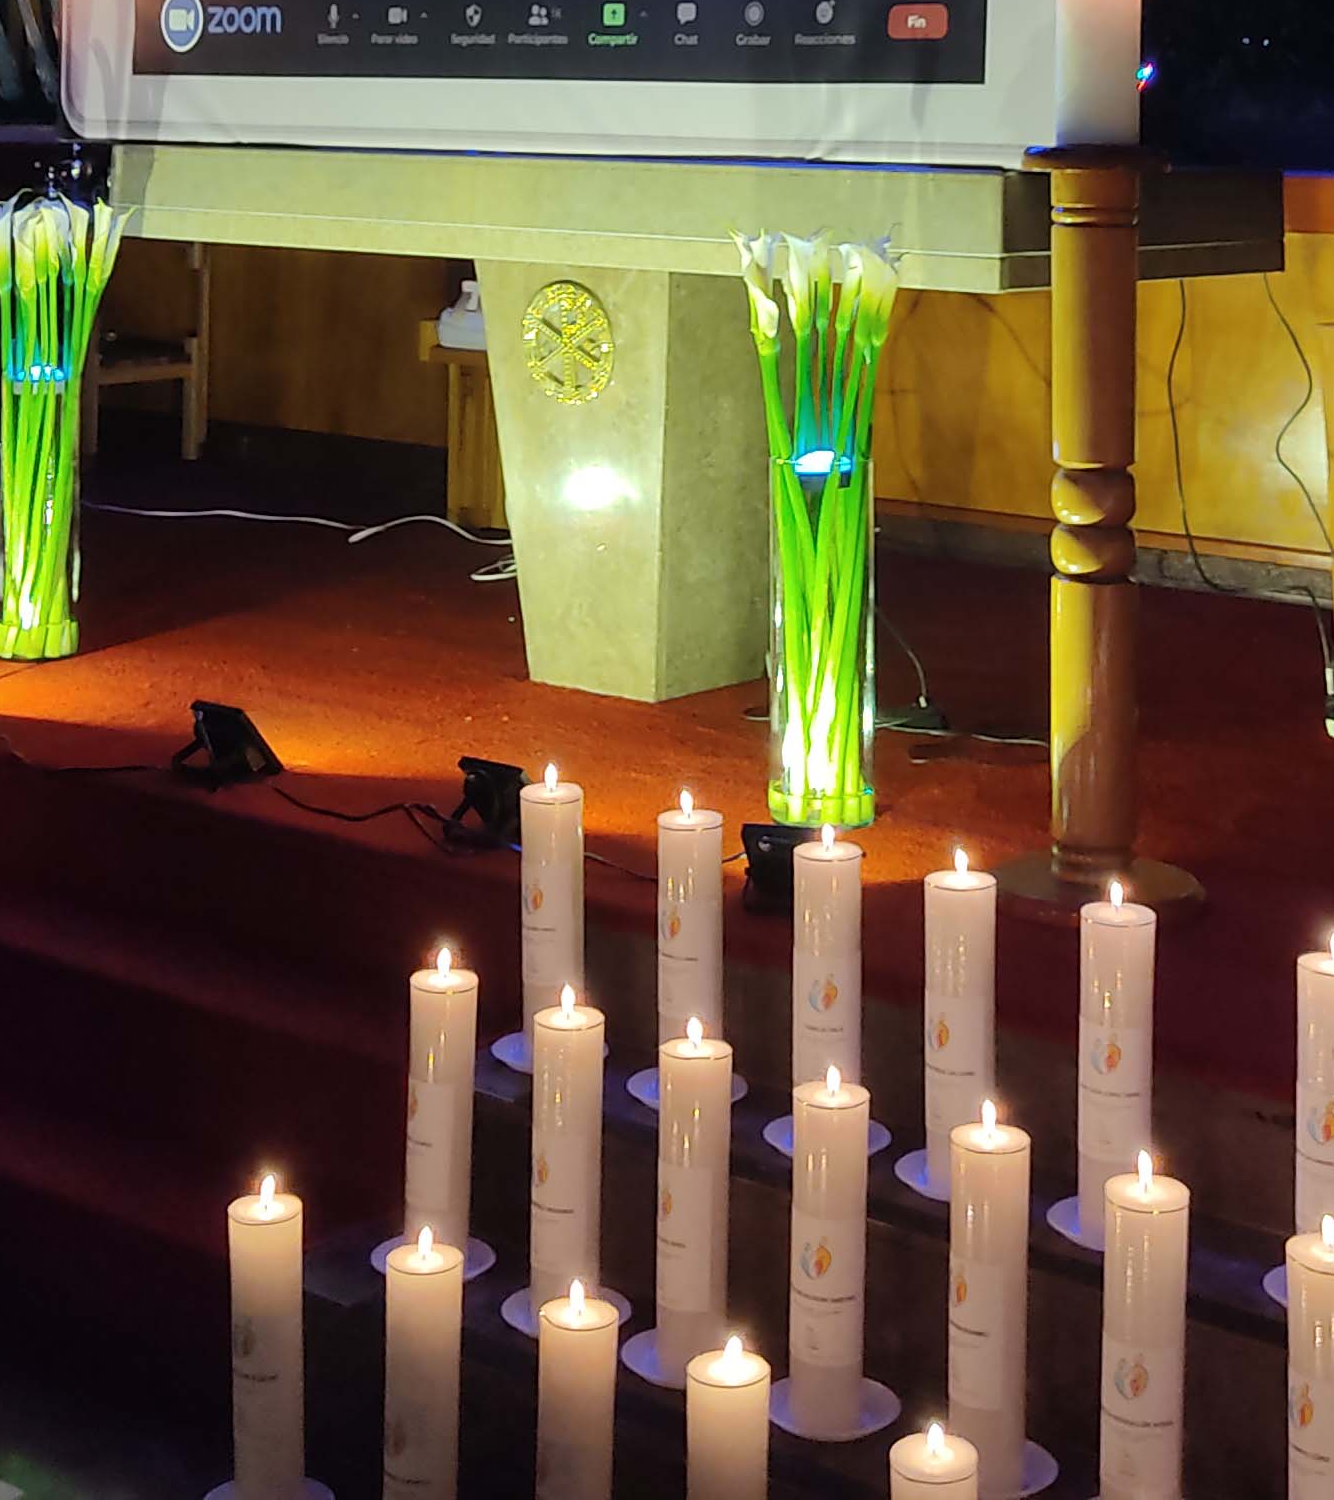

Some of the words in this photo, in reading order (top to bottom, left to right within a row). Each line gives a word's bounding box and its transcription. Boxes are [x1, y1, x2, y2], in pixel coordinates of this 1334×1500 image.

[207, 5, 282, 34] zoom
[906, 14, 927, 29] Fin
[673, 32, 699, 45] Chat
